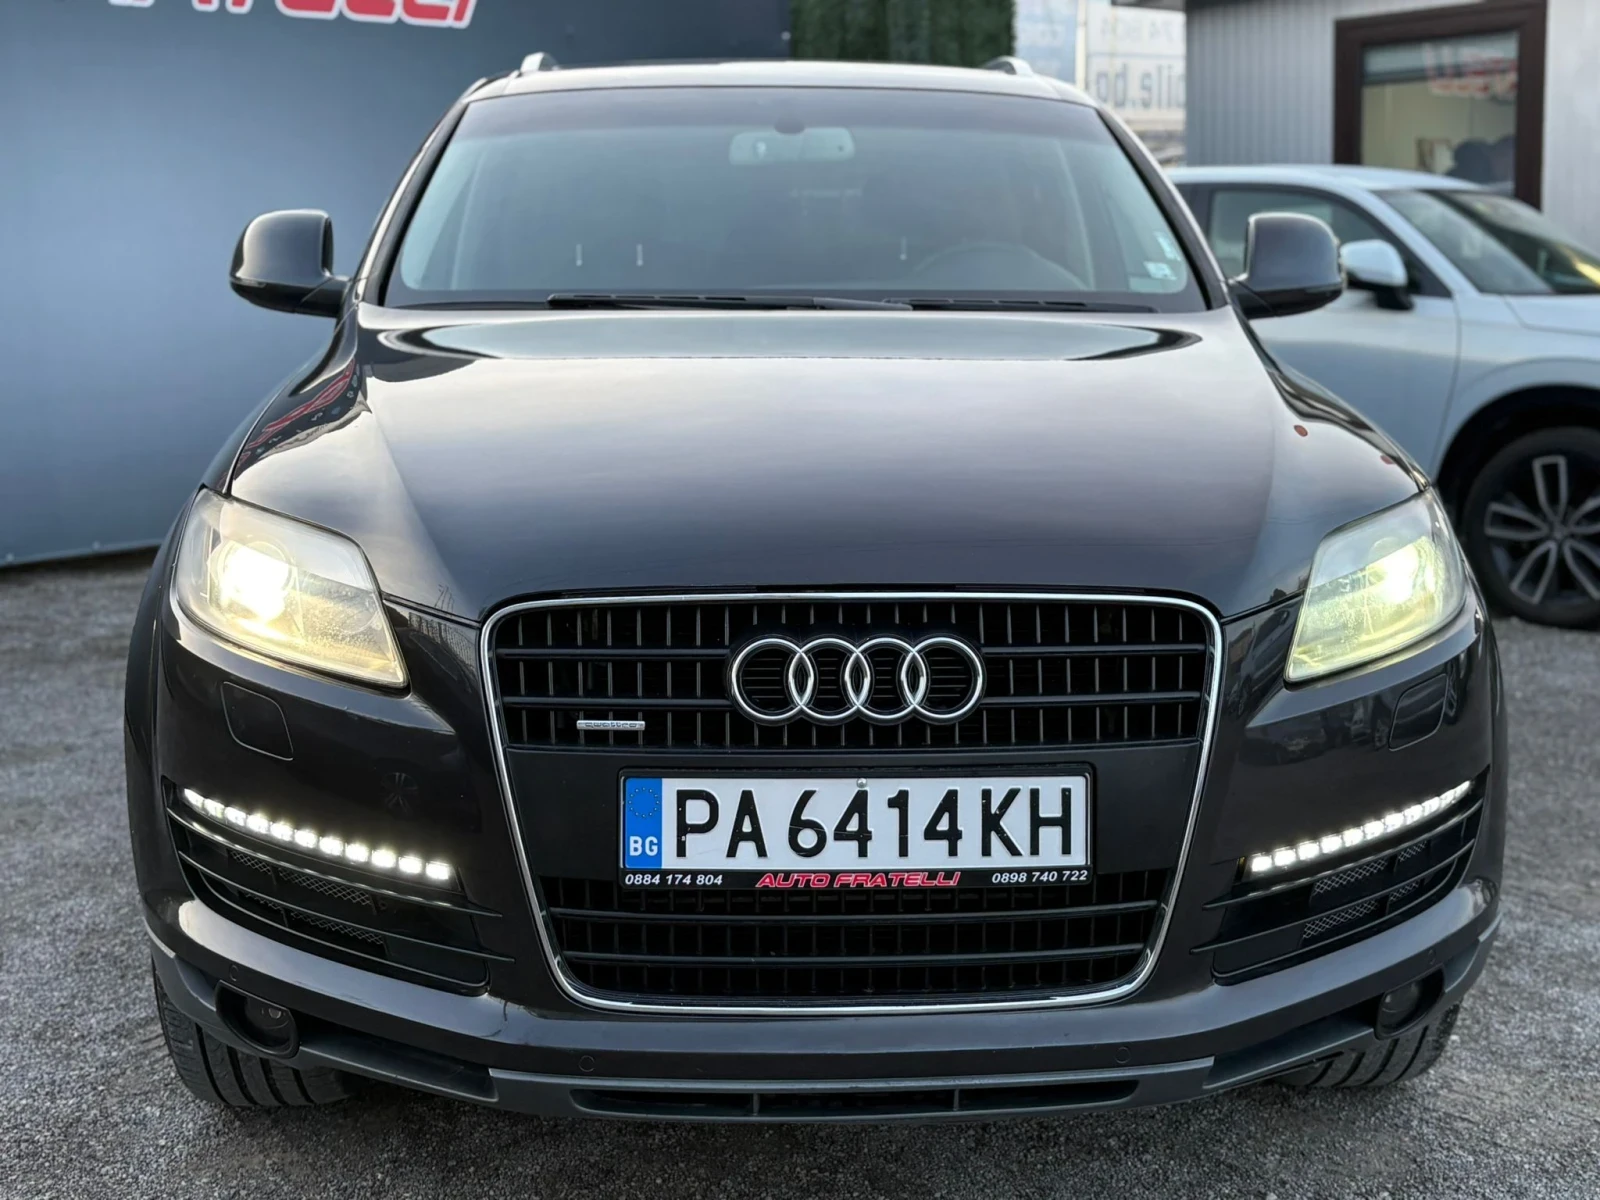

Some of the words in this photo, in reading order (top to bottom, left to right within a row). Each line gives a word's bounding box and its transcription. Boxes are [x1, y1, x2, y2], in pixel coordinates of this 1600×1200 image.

[585, 721, 638, 729] quattro
[676, 789, 768, 858] PA
[788, 788, 963, 858] 6414
[981, 787, 1072, 857] KH
[629, 836, 658, 856] BG
[625, 873, 660, 885] 0884
[665, 873, 692, 885] 174
[696, 873, 723, 885] 804
[756, 873, 831, 888] AUTO
[833, 871, 961, 888] FRATELLI
[991, 872, 1027, 884] 0898
[1031, 871, 1058, 883] 740
[1062, 869, 1088, 881] 722
